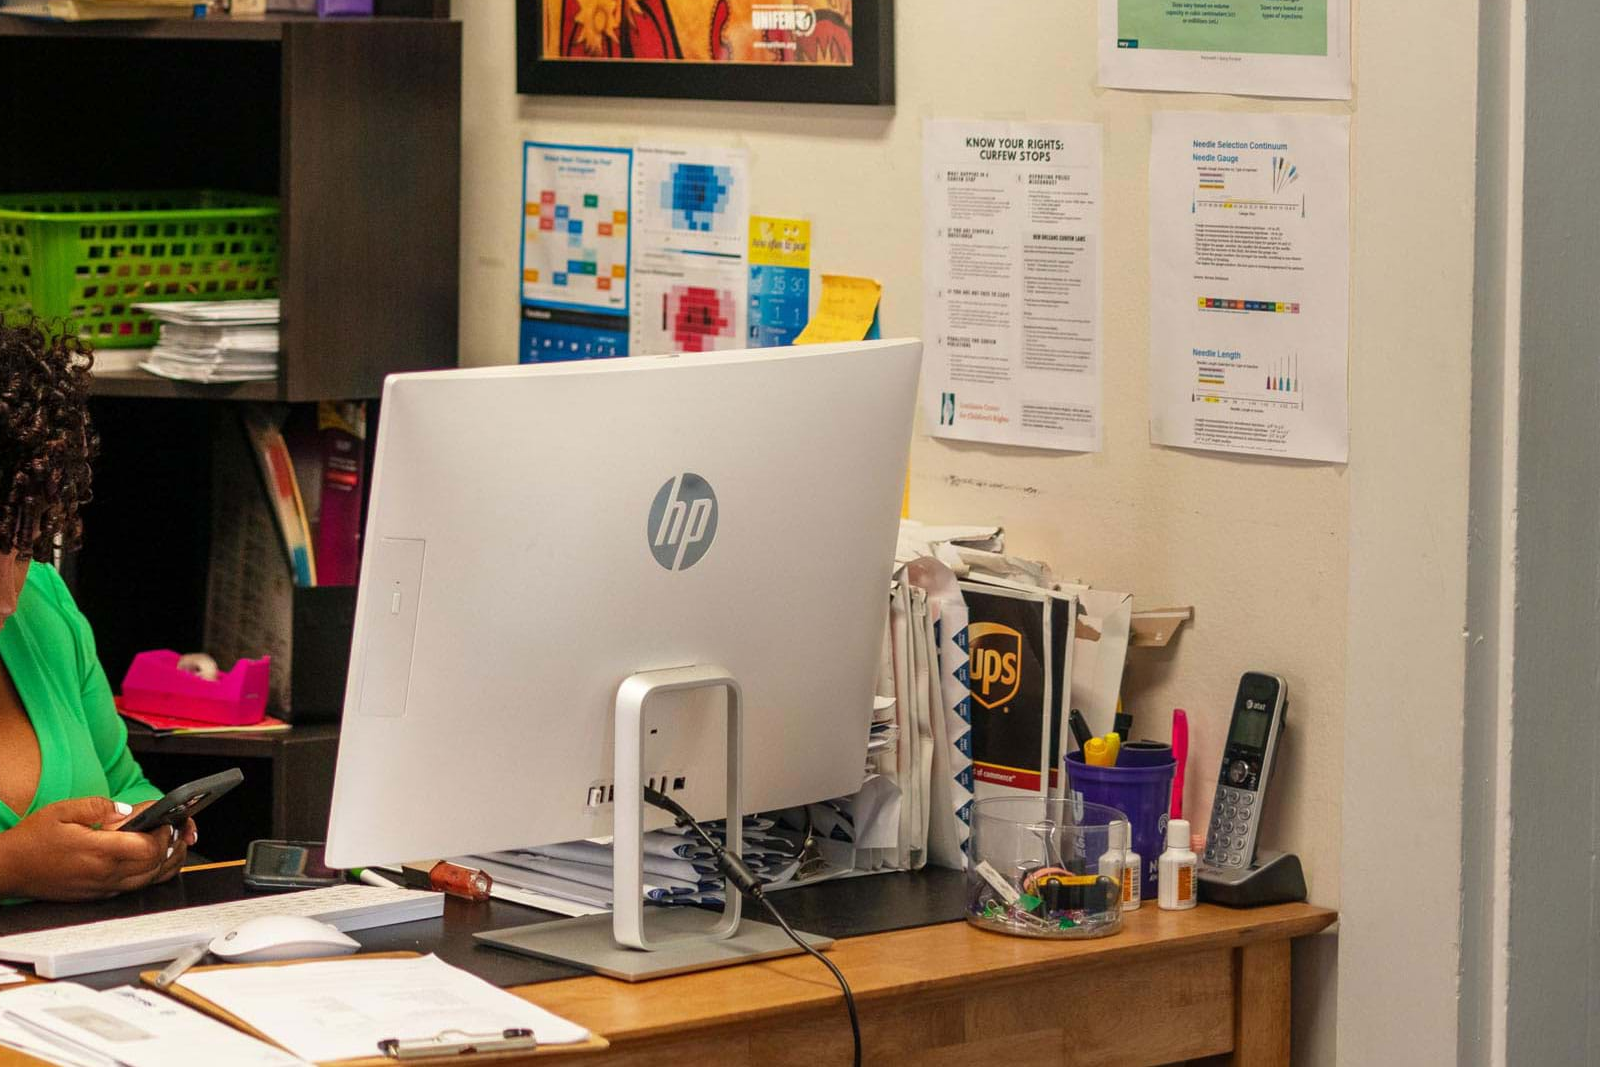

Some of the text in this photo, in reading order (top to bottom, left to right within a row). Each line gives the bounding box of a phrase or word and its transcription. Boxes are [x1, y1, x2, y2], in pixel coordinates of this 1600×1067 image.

[752, 11, 795, 30] UNIFEM
[966, 138, 1064, 150] KNOW YOUR RIGHTS:
[1250, 142, 1287, 150] Continuum
[980, 150, 1051, 162] CURFEW STOPS
[1217, 154, 1238, 163] Gauge
[1193, 348, 1241, 360] Needle Length
[653, 473, 714, 571] hp
[970, 648, 1017, 695] ups
